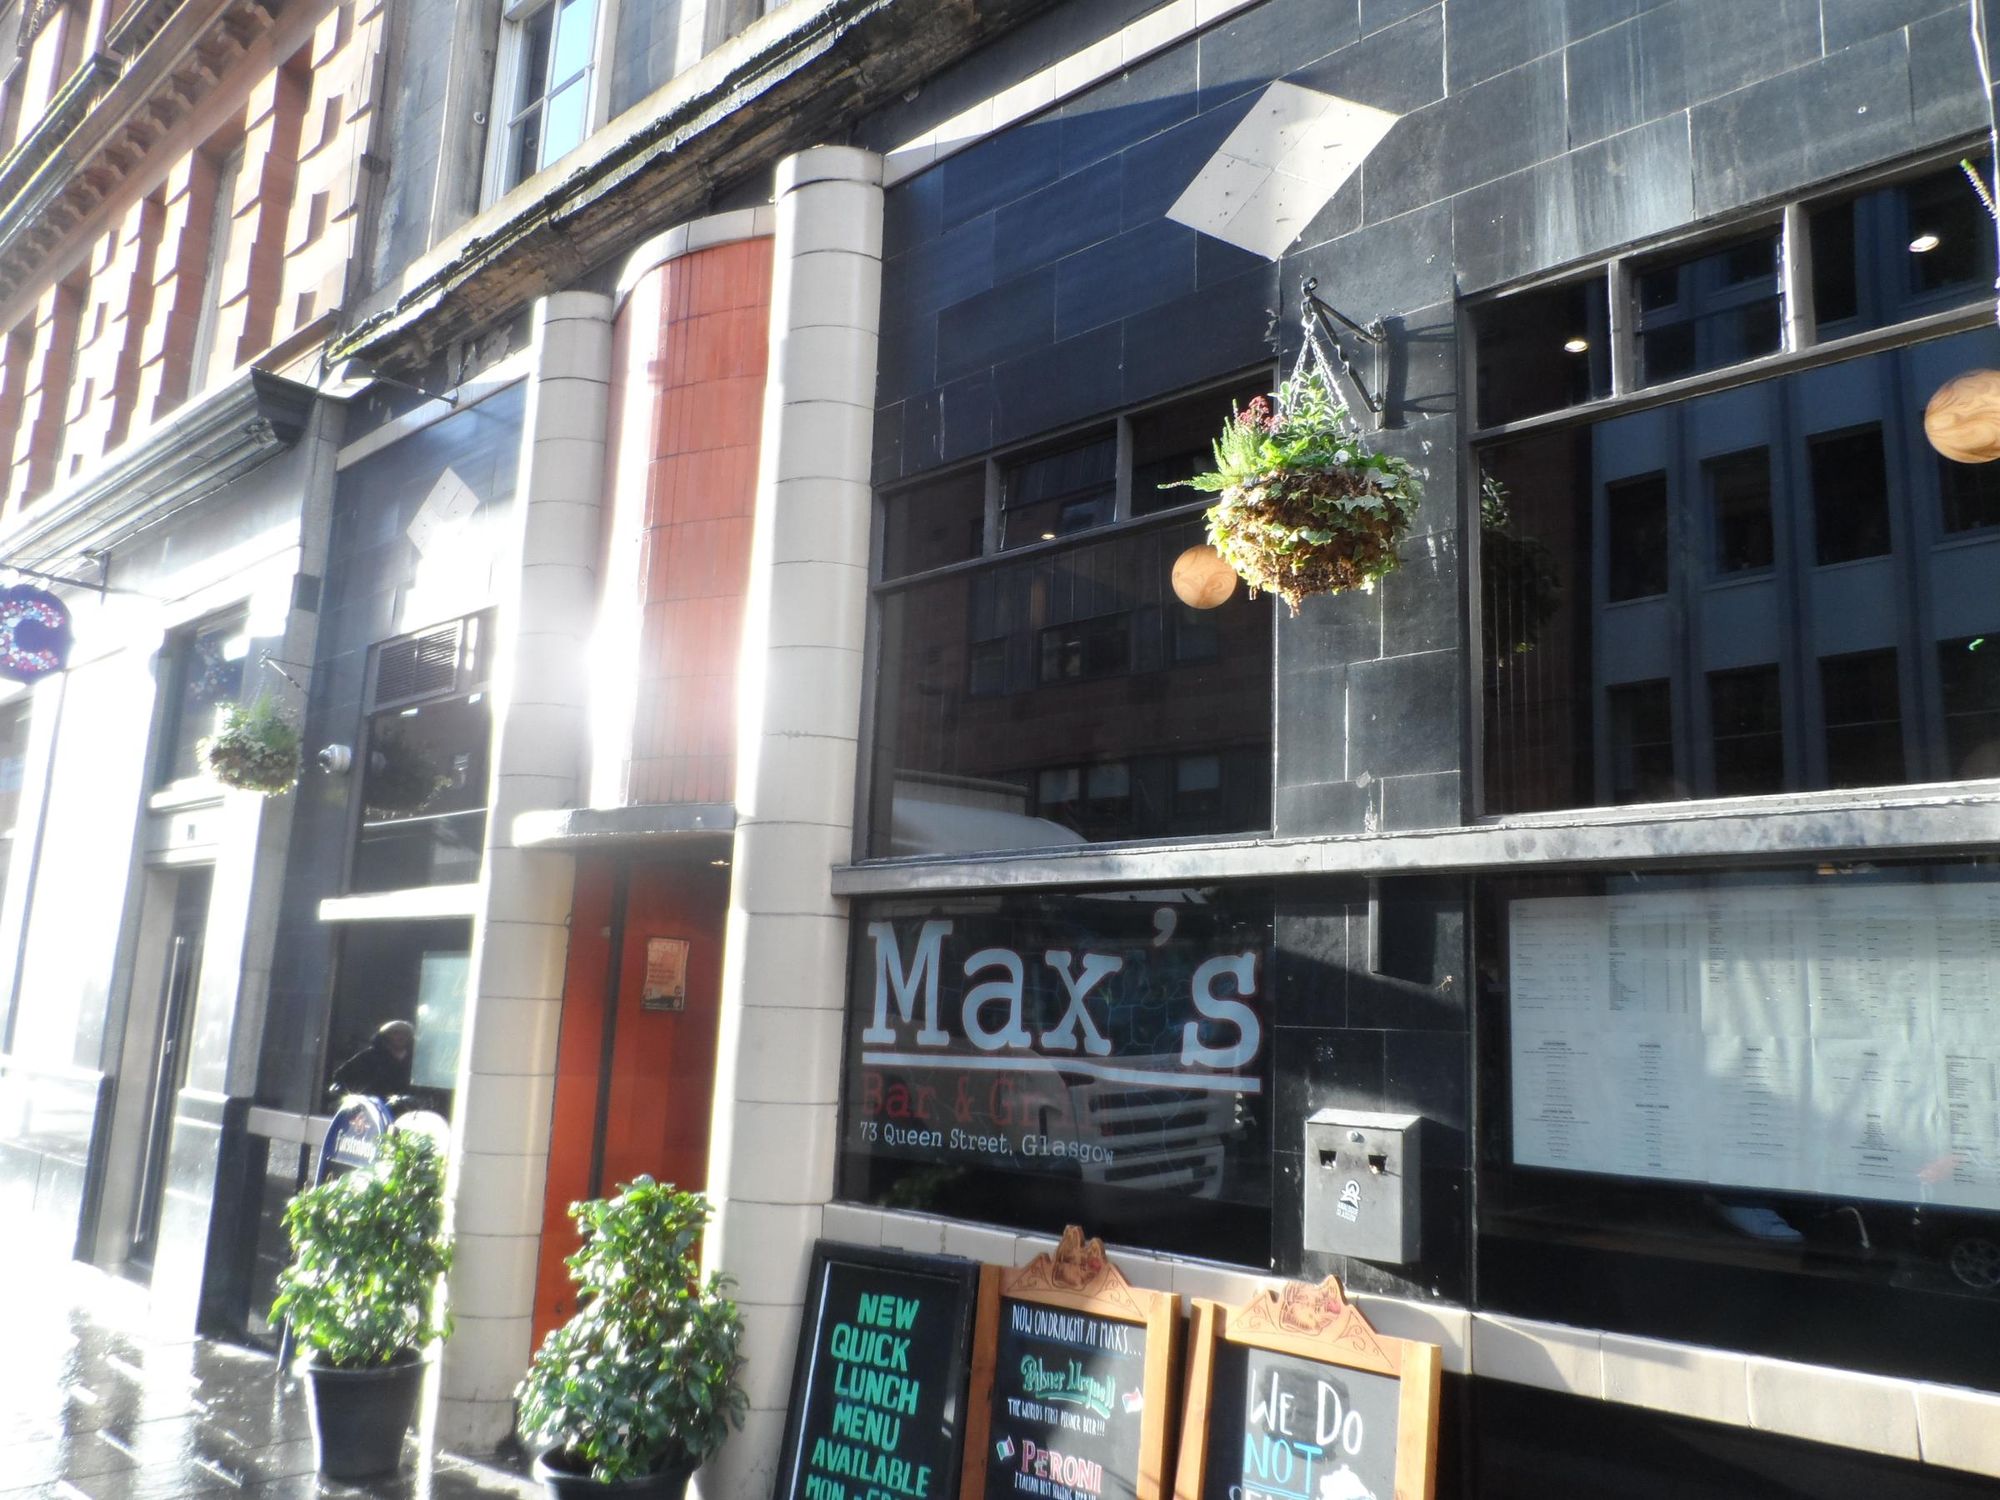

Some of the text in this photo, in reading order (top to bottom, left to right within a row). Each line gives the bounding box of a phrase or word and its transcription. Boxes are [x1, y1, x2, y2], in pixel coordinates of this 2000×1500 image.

[862, 907, 1261, 1068] Max's
[863, 1072, 936, 1118] Bar
[955, 1077, 974, 1122] &
[860, 1121, 1114, 1165] 73 Queen Street, Glasgow
[857, 1293, 920, 1330] NEW
[1012, 1304, 1032, 1333] NOW
[1034, 1310, 1048, 1336] ON
[1086, 1320, 1097, 1346] AT
[831, 1323, 911, 1372] QUICK
[834, 1363, 919, 1415] LUNCH
[1021, 1354, 1066, 1392] Pilsner
[832, 1402, 900, 1451] MENU
[1250, 1368, 1295, 1436] WE
[811, 1438, 932, 1498] AVAILABLE
[1022, 1440, 1103, 1494] PERONI
[1244, 1433, 1323, 1493] NOT
